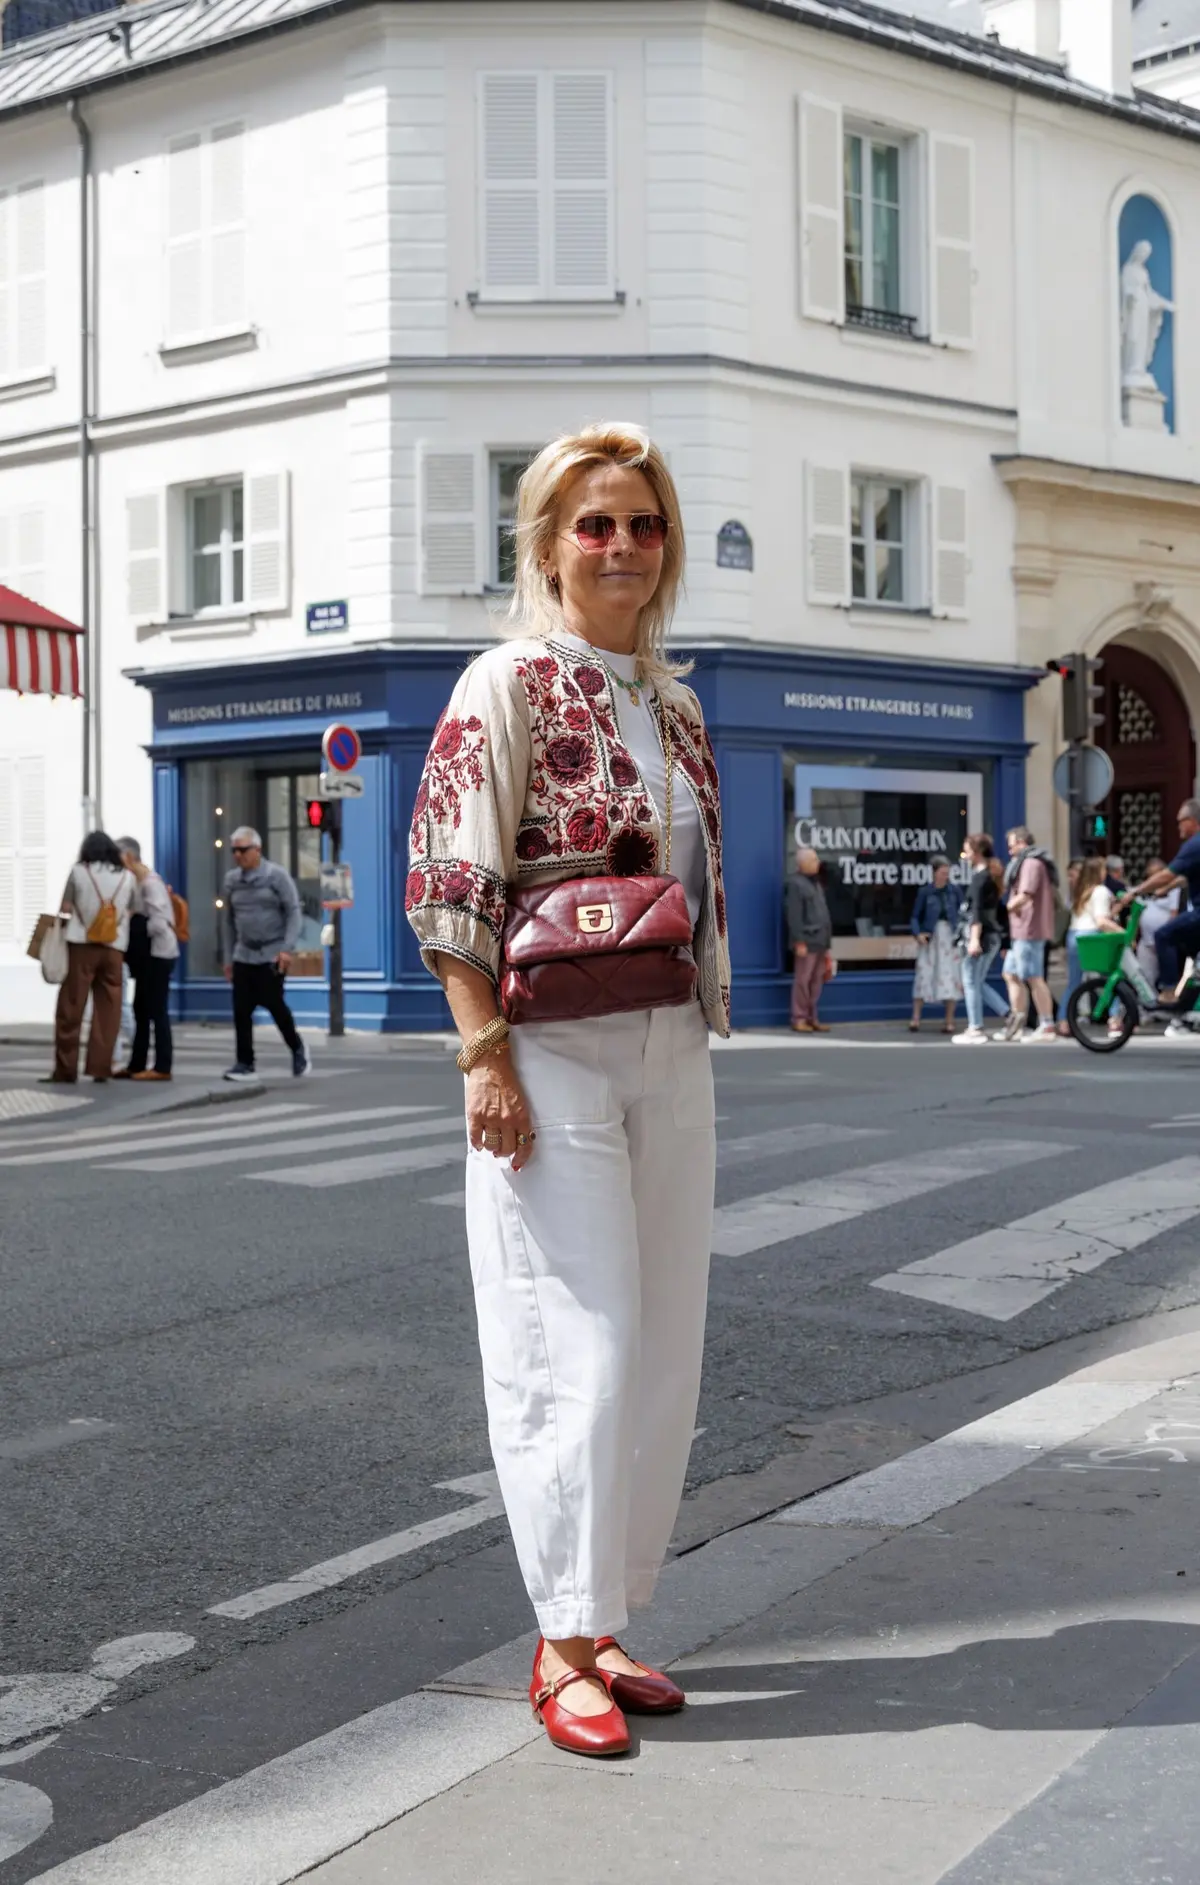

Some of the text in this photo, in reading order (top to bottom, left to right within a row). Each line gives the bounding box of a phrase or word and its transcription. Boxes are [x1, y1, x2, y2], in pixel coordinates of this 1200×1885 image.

[168, 692, 362, 722] MISSIONS ETRANGERES DE PARIS
[784, 692, 974, 720] MISSIONS ETRANGERES DE PARIS
[794, 819, 947, 851] Cieux nouveaux
[838, 856, 972, 886] Terre noell
